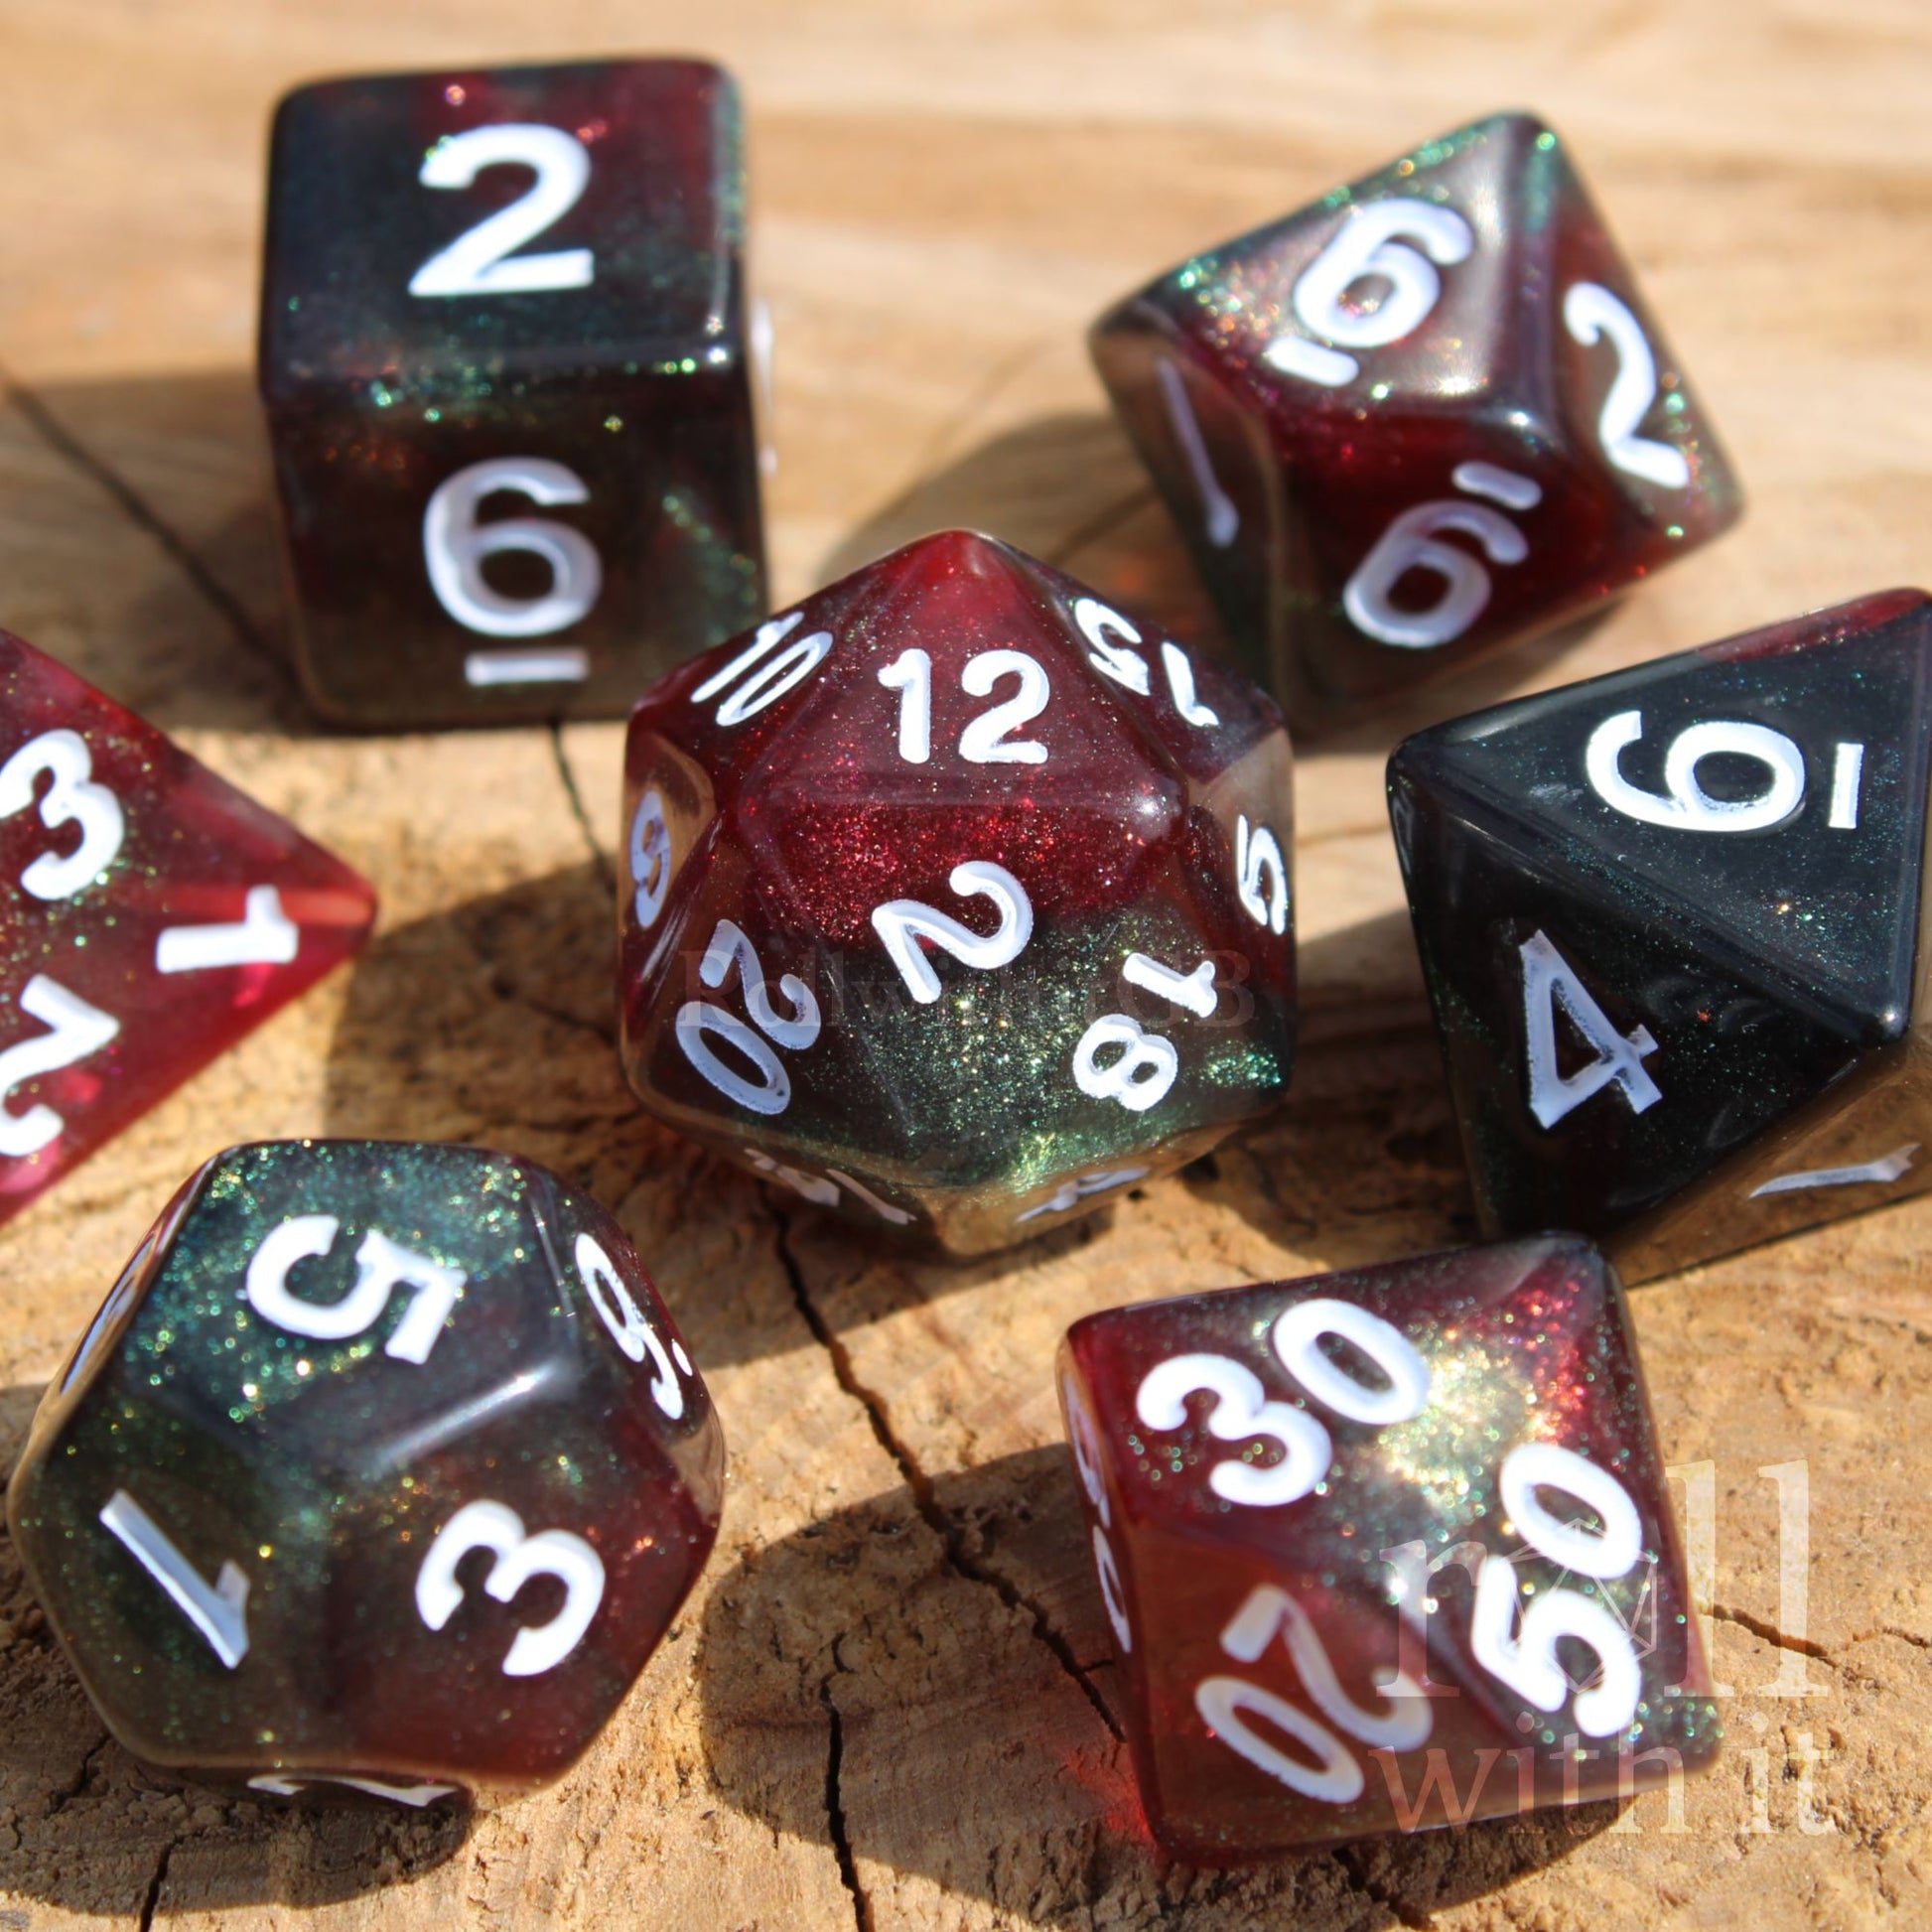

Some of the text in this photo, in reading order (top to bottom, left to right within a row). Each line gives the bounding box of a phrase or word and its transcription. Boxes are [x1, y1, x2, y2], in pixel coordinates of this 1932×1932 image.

[409, 123, 594, 297] 2
[1293, 199, 1474, 348] 6
[1563, 282, 1693, 489] 2
[423, 457, 601, 637] 6
[690, 611, 834, 727] 10
[877, 647, 1050, 765] 12
[1073, 597, 1221, 728] 15
[0, 728, 125, 900] 3
[1586, 710, 1805, 833] 6
[156, 885, 299, 974] 1
[870, 860, 1035, 1005] 2
[1236, 813, 1289, 935] 5
[0, 973, 120, 1157] 2
[675, 918, 822, 1116] 20
[1071, 949, 1219, 1114] 18
[1517, 928, 1664, 1132] 4
[244, 1214, 469, 1365] 5
[1135, 1296, 1433, 1507] 30
[99, 1489, 250, 1670] 1
[414, 1499, 607, 1678] 3
[1470, 1441, 1643, 1739] 50
[1194, 1586, 1434, 1805] 20
